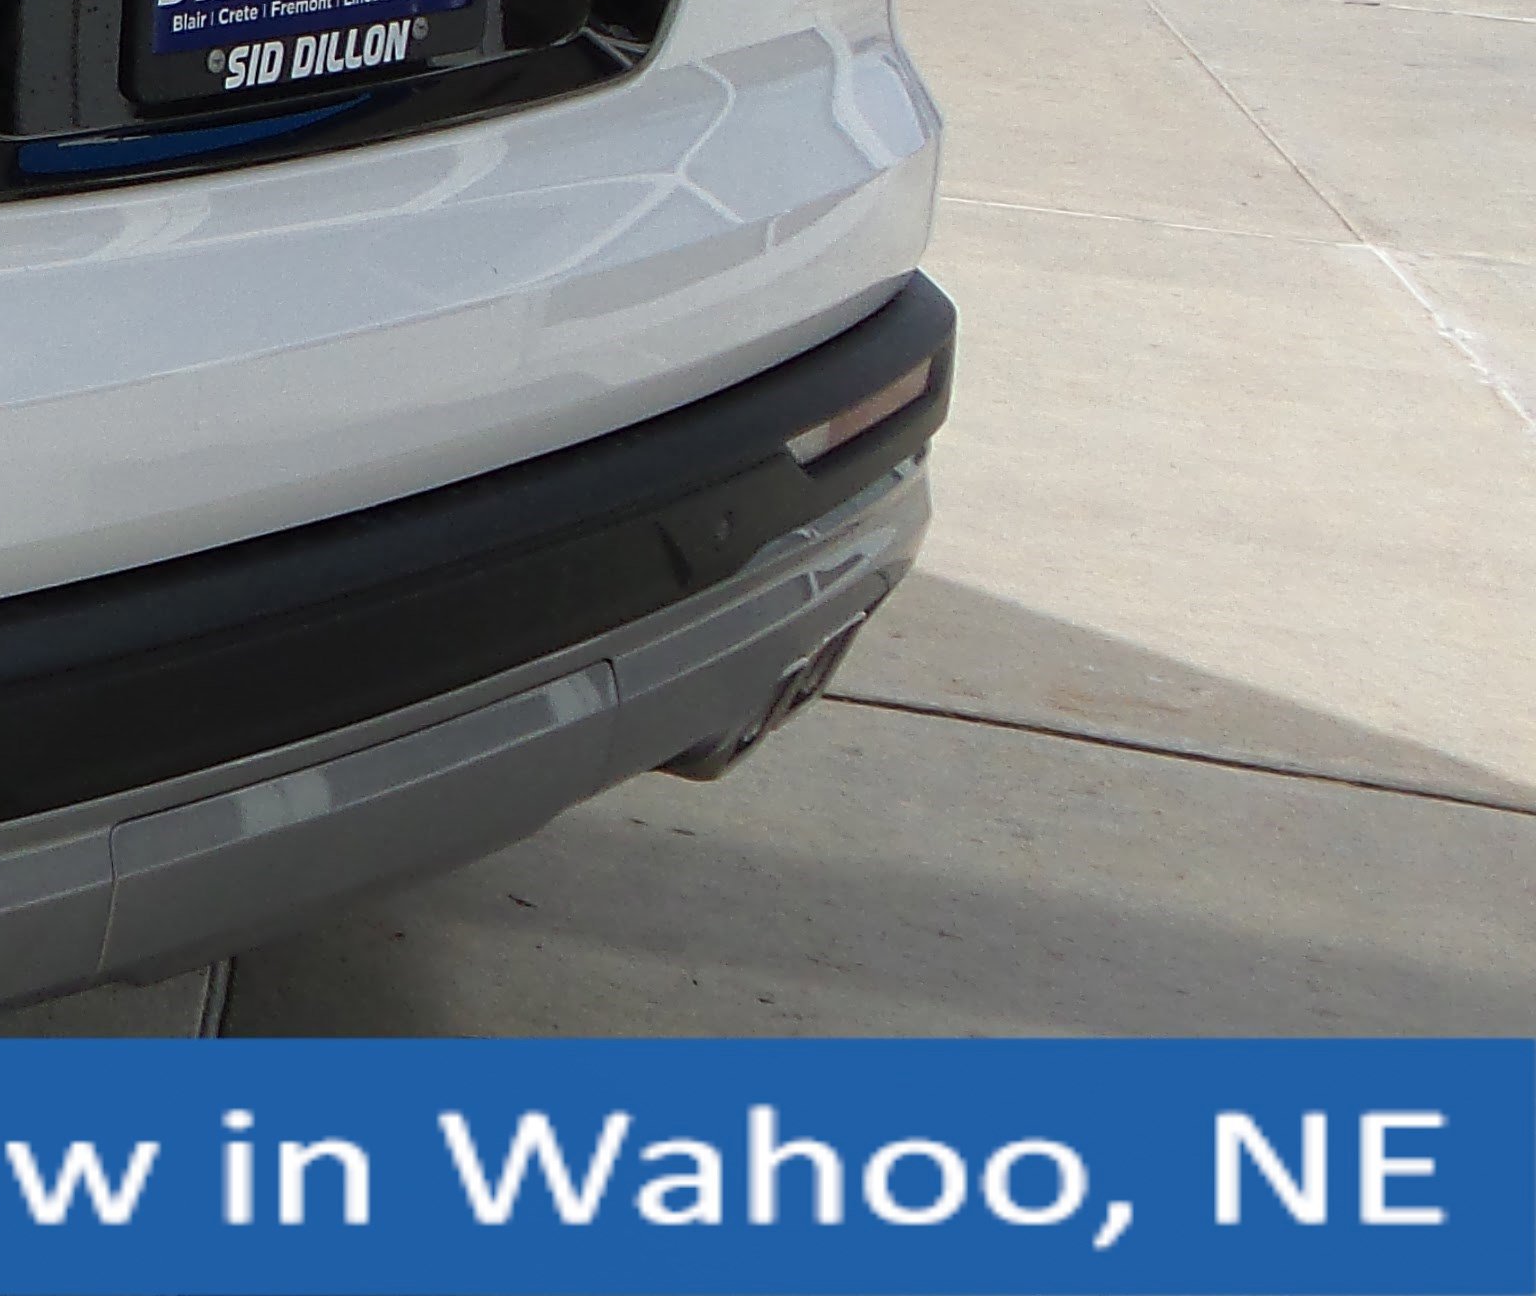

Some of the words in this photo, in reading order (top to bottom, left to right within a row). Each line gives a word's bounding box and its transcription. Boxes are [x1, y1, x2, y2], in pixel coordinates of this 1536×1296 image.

[172, 14, 208, 32] Blair
[218, 7, 259, 26] Crete
[225, 40, 284, 89] SID
[291, 19, 412, 79] DILLON
